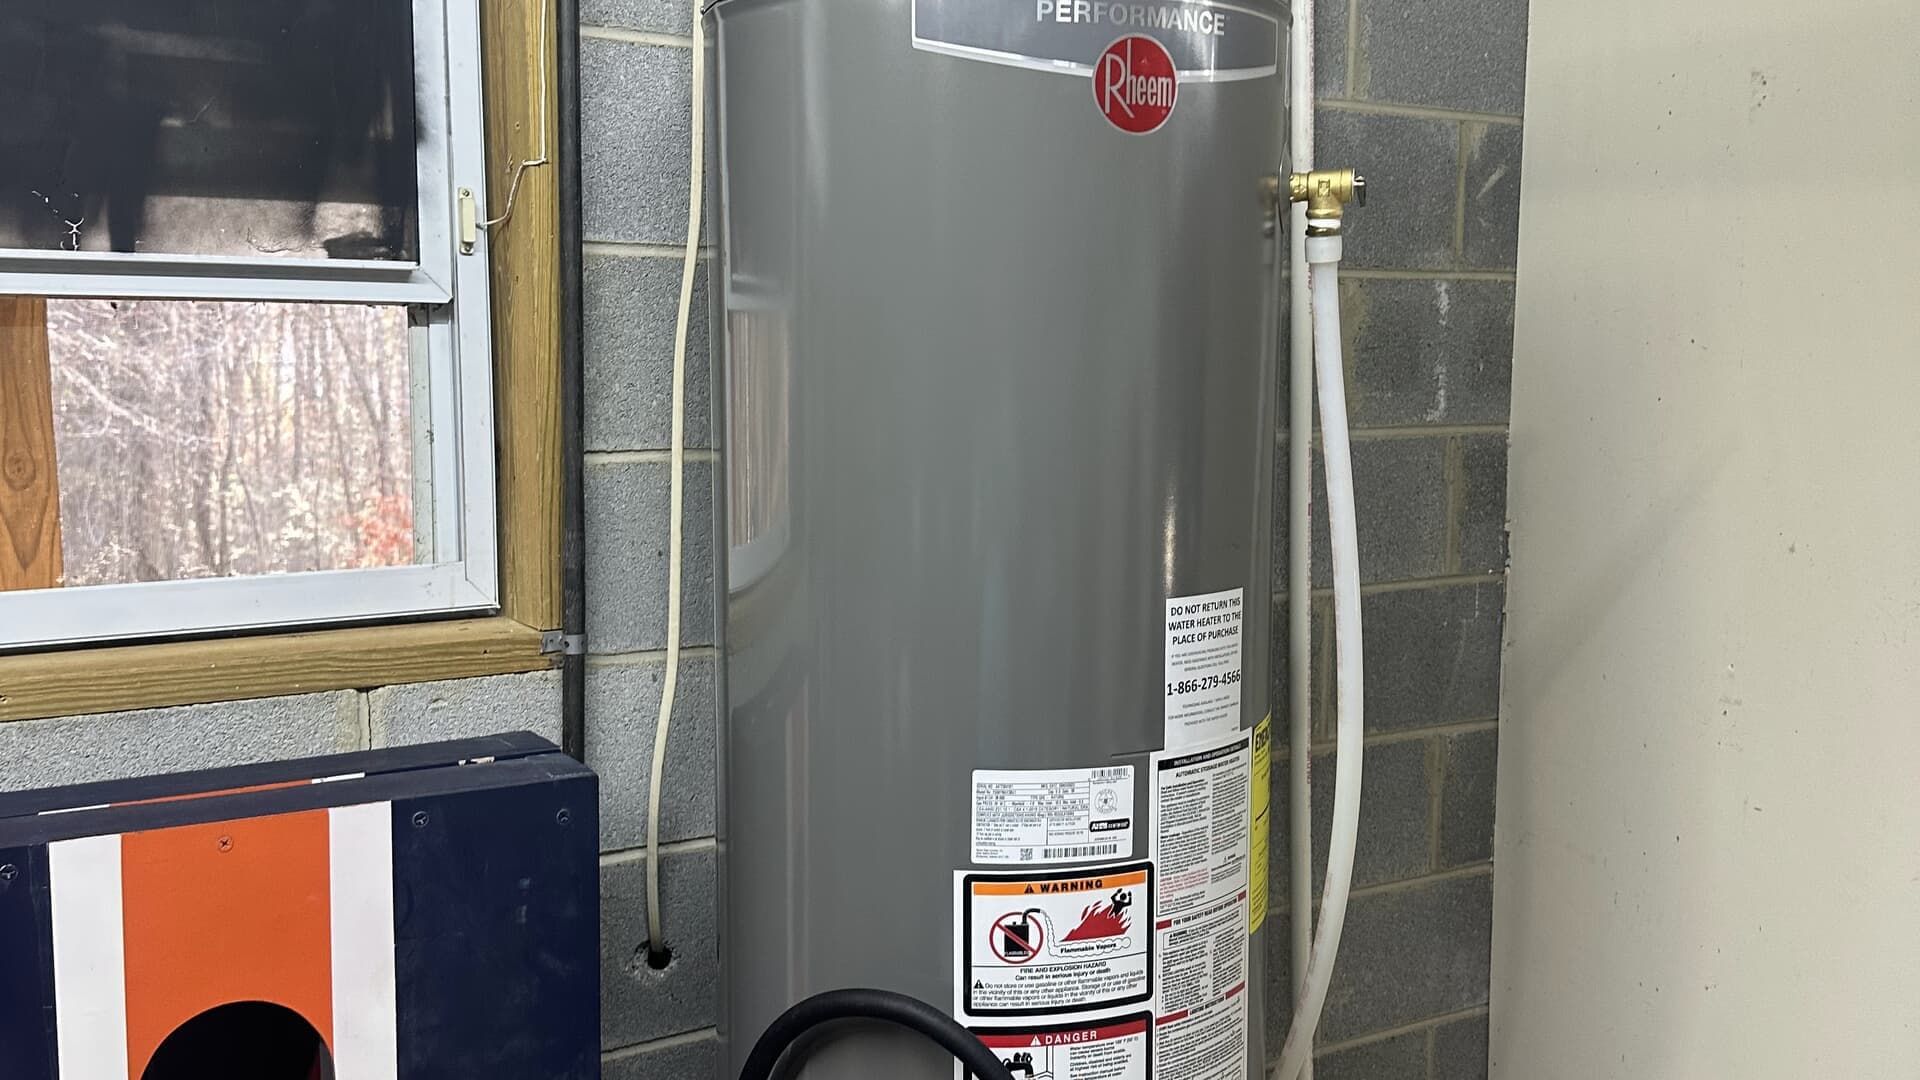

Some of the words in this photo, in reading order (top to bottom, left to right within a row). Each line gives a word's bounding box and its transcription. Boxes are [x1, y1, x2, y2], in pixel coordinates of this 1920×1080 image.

[1036, 0, 1224, 35] PERFORMANCE
[1105, 38, 1172, 118] Rheem
[1171, 606, 1183, 616] DO
[1185, 604, 1201, 615] NOT
[1202, 600, 1228, 612] RETURN
[1229, 597, 1241, 607] THIS
[1168, 620, 1195, 631] WATER
[1197, 616, 1221, 627] HEATER
[1223, 614, 1231, 623] TO
[1232, 611, 1241, 620] THE
[1172, 634, 1196, 645] PLACE
[1197, 632, 1207, 641] OF
[1208, 625, 1239, 640] PURCHASE
[1167, 669, 1241, 696] 1-866-279-4566
[1040, 880, 1103, 893] WARNING
[1061, 945, 1094, 954] Flammable
[1045, 1030, 1097, 1045] DANGER
